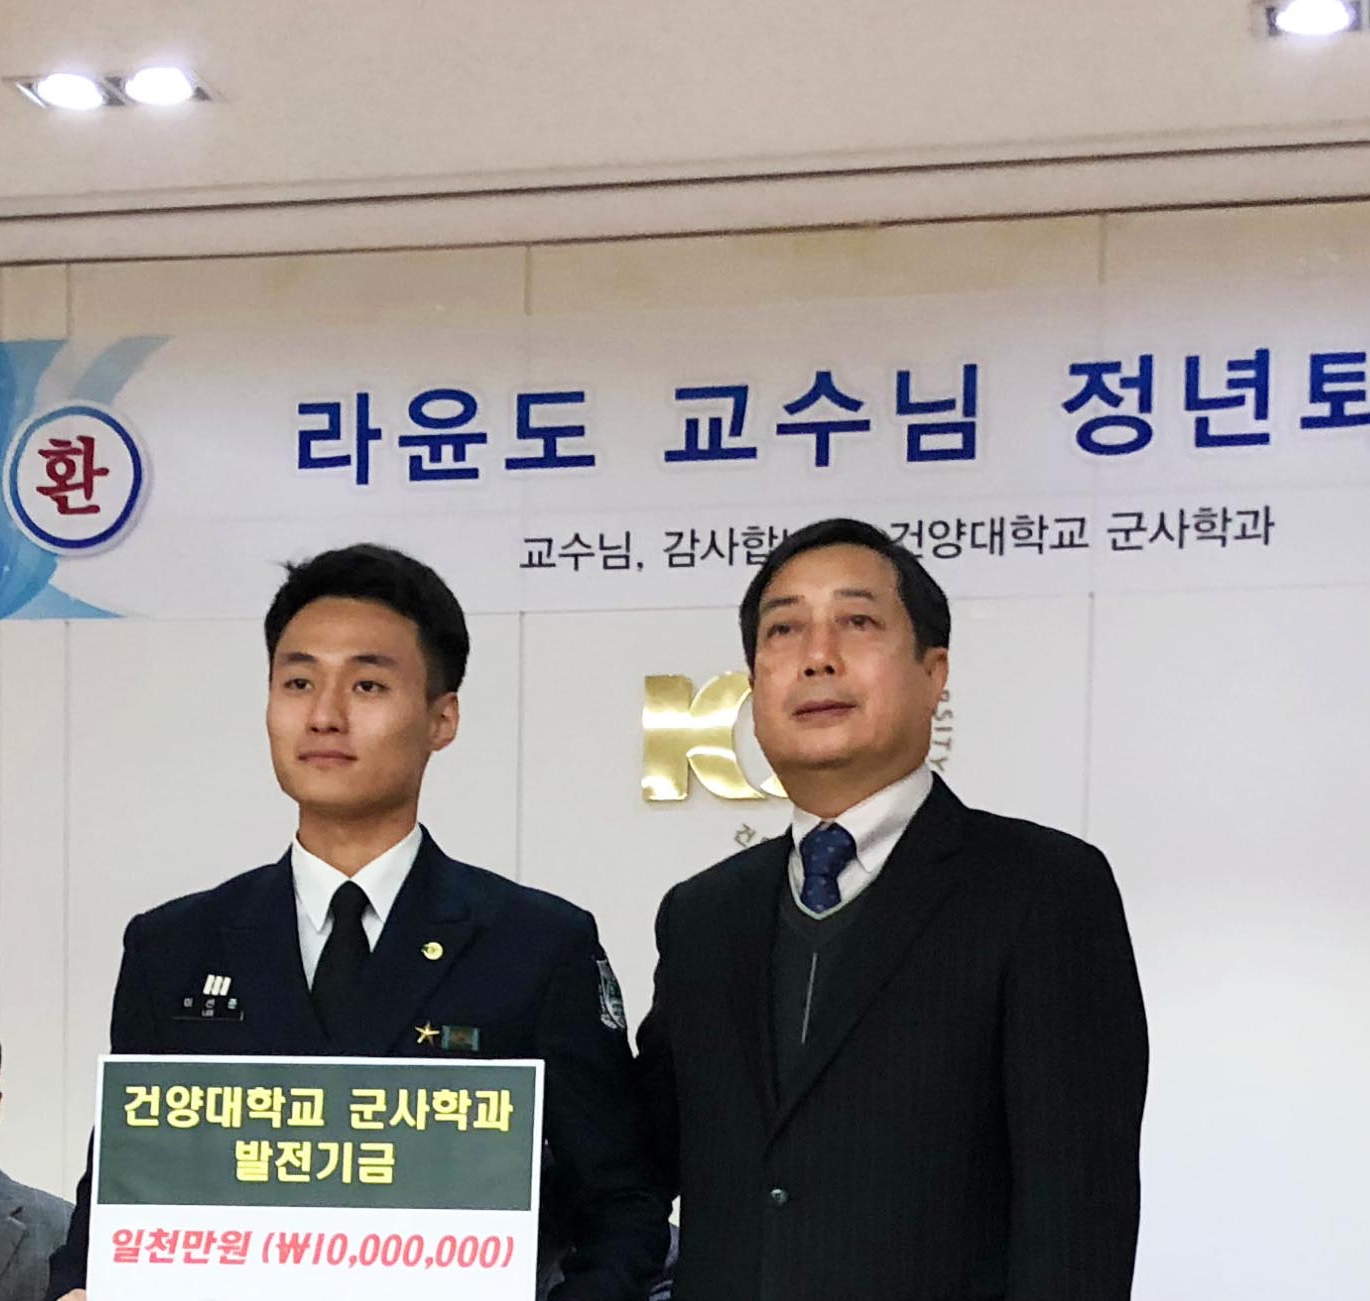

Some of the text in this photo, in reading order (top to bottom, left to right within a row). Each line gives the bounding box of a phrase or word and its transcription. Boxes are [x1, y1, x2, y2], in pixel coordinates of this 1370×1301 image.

[296, 387, 597, 486] 라윤도
[663, 363, 978, 468] 교수님
[36, 434, 110, 516] 환
[519, 530, 644, 572] 교수님,
[1106, 504, 1276, 552] 군사학과
[124, 1084, 514, 1132] 건양대학교 군사학과
[234, 1139, 397, 1185] 발전기금
[111, 1227, 254, 1266] 일천만원
